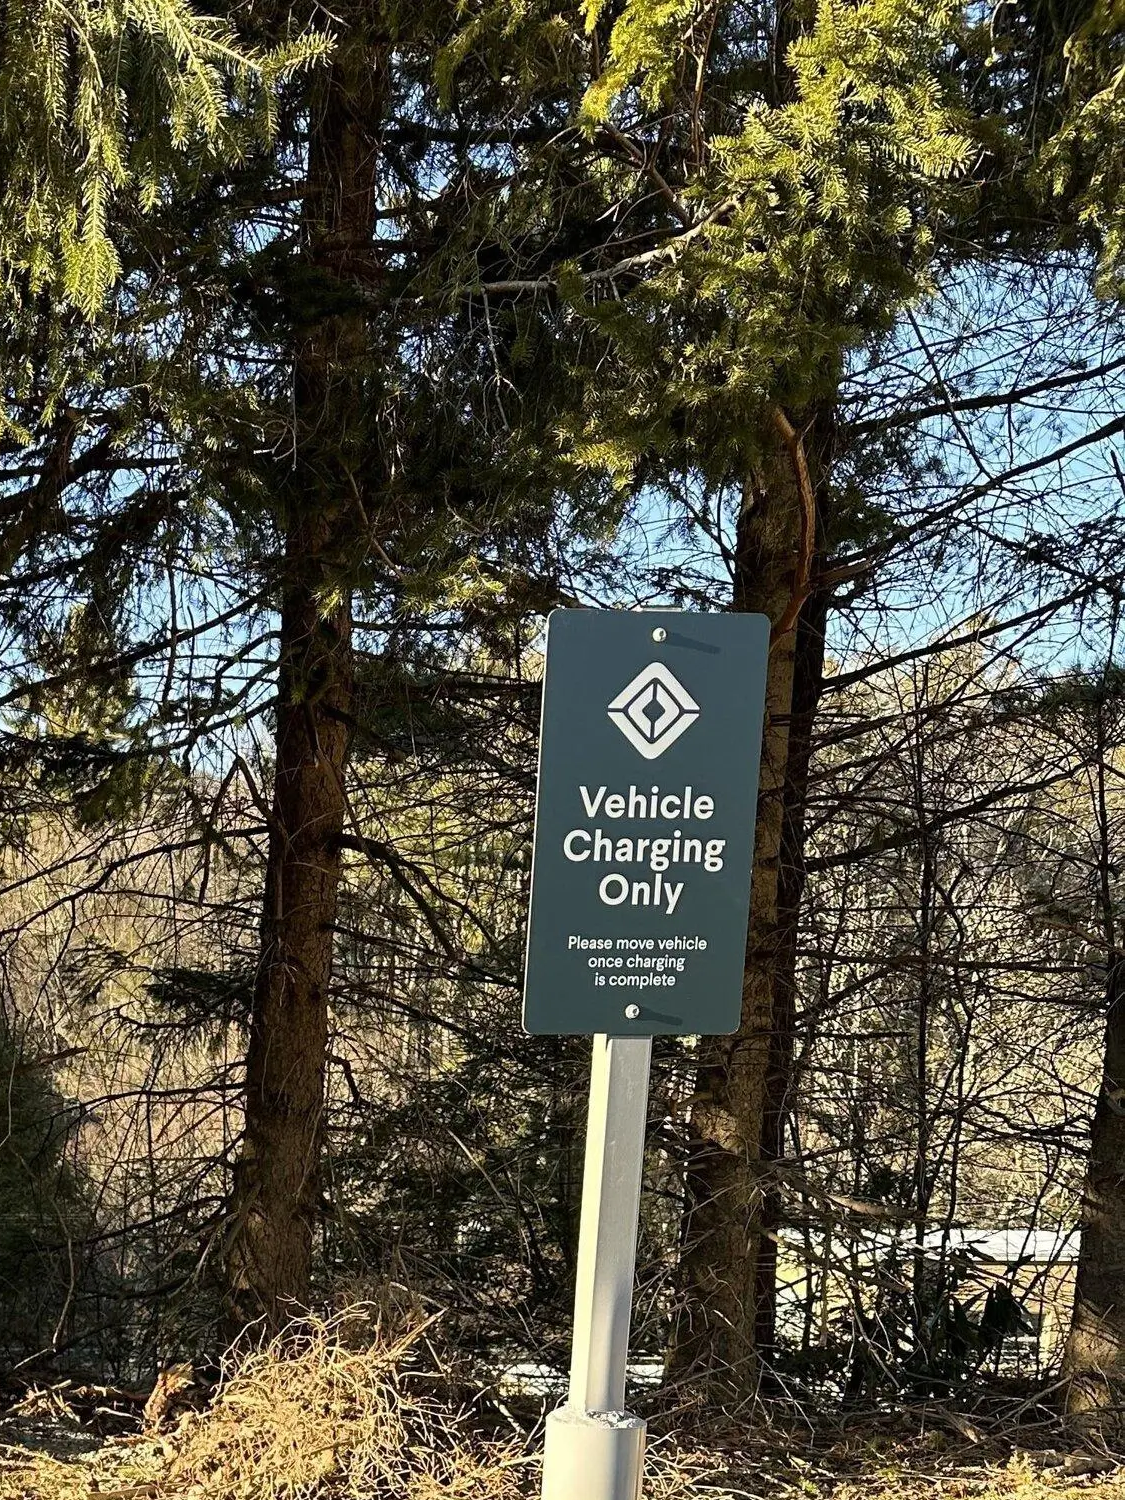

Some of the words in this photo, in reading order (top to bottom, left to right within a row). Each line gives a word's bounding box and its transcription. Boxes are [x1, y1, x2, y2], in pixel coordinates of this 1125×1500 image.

[579, 785, 715, 820] Vehicle
[563, 828, 726, 873] Charging
[598, 873, 685, 915] Only
[567, 935, 613, 950] Please
[616, 938, 655, 950] move
[657, 935, 708, 950] vehicle
[587, 957, 624, 968] once
[626, 953, 686, 972] charging
[594, 971, 606, 986] is
[608, 971, 676, 990] complete
